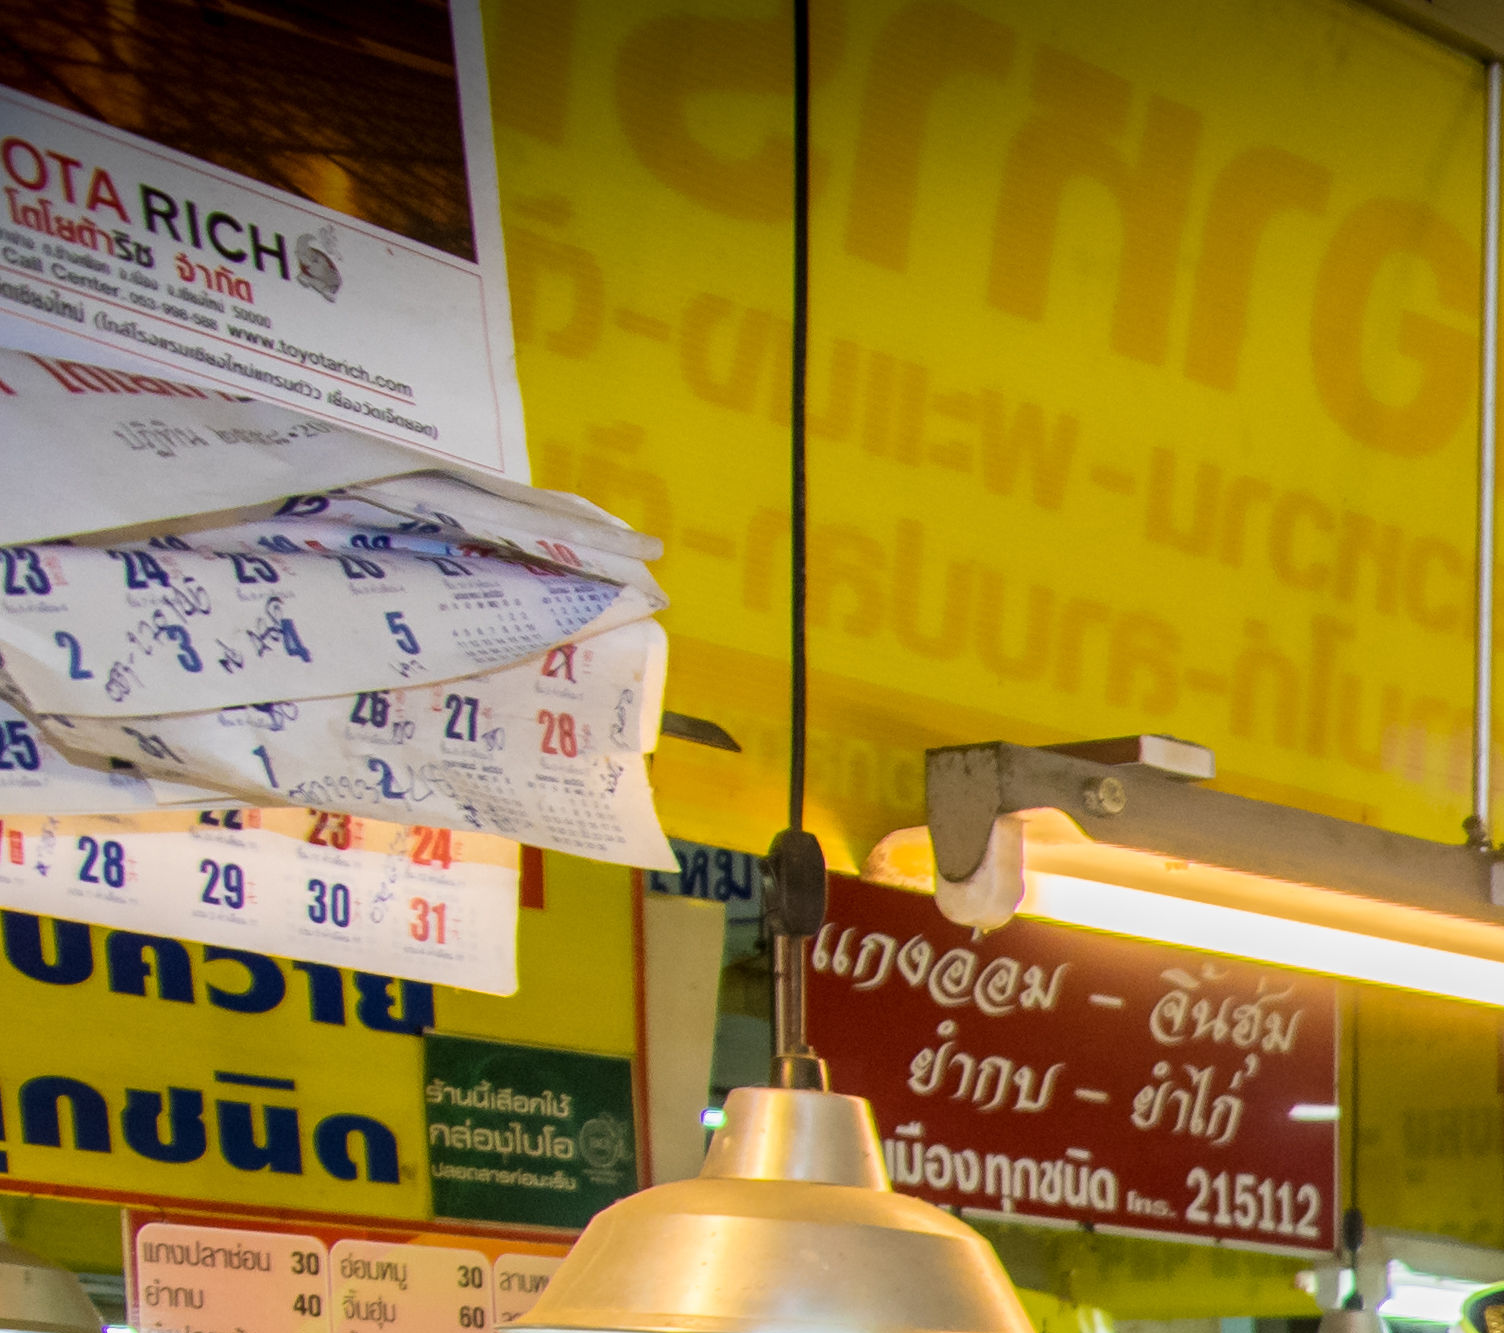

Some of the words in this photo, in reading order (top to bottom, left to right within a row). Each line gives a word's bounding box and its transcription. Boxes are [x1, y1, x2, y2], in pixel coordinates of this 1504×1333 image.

[2, 137, 131, 224] OTA
[140, 183, 292, 280] RICH
[2, 246, 44, 275] Call
[52, 263, 121, 298] Center
[227, 324, 415, 398] www.toyotarich.com
[2, 547, 51, 595] 23
[55, 631, 94, 680] 2
[163, 624, 203, 672] 3
[279, 618, 313, 663] 4
[385, 611, 421, 655] 5
[444, 693, 480, 742] 27
[536, 709, 578, 757] 28
[253, 745, 279, 788] 1
[367, 757, 407, 800] 2
[307, 807, 353, 850] 23
[410, 826, 452, 870] 24
[77, 836, 125, 888] 28
[200, 858, 245, 910] 29
[307, 879, 351, 928] 30
[409, 897, 447, 944] 31
[909, 1020, 1066, 1113] ยำกบ
[1130, 1060, 1246, 1148] ยำไก่
[0, 1070, 402, 1186] กชนิด
[1185, 1167, 1321, 1239] 215112
[142, 1239, 272, 1274] แกงปลาช่อน
[290, 1250, 320, 1276] 30
[457, 1264, 483, 1289] 30
[145, 1281, 204, 1310] ยำกบ
[292, 1292, 321, 1318] 40
[459, 1305, 485, 1330] 60
